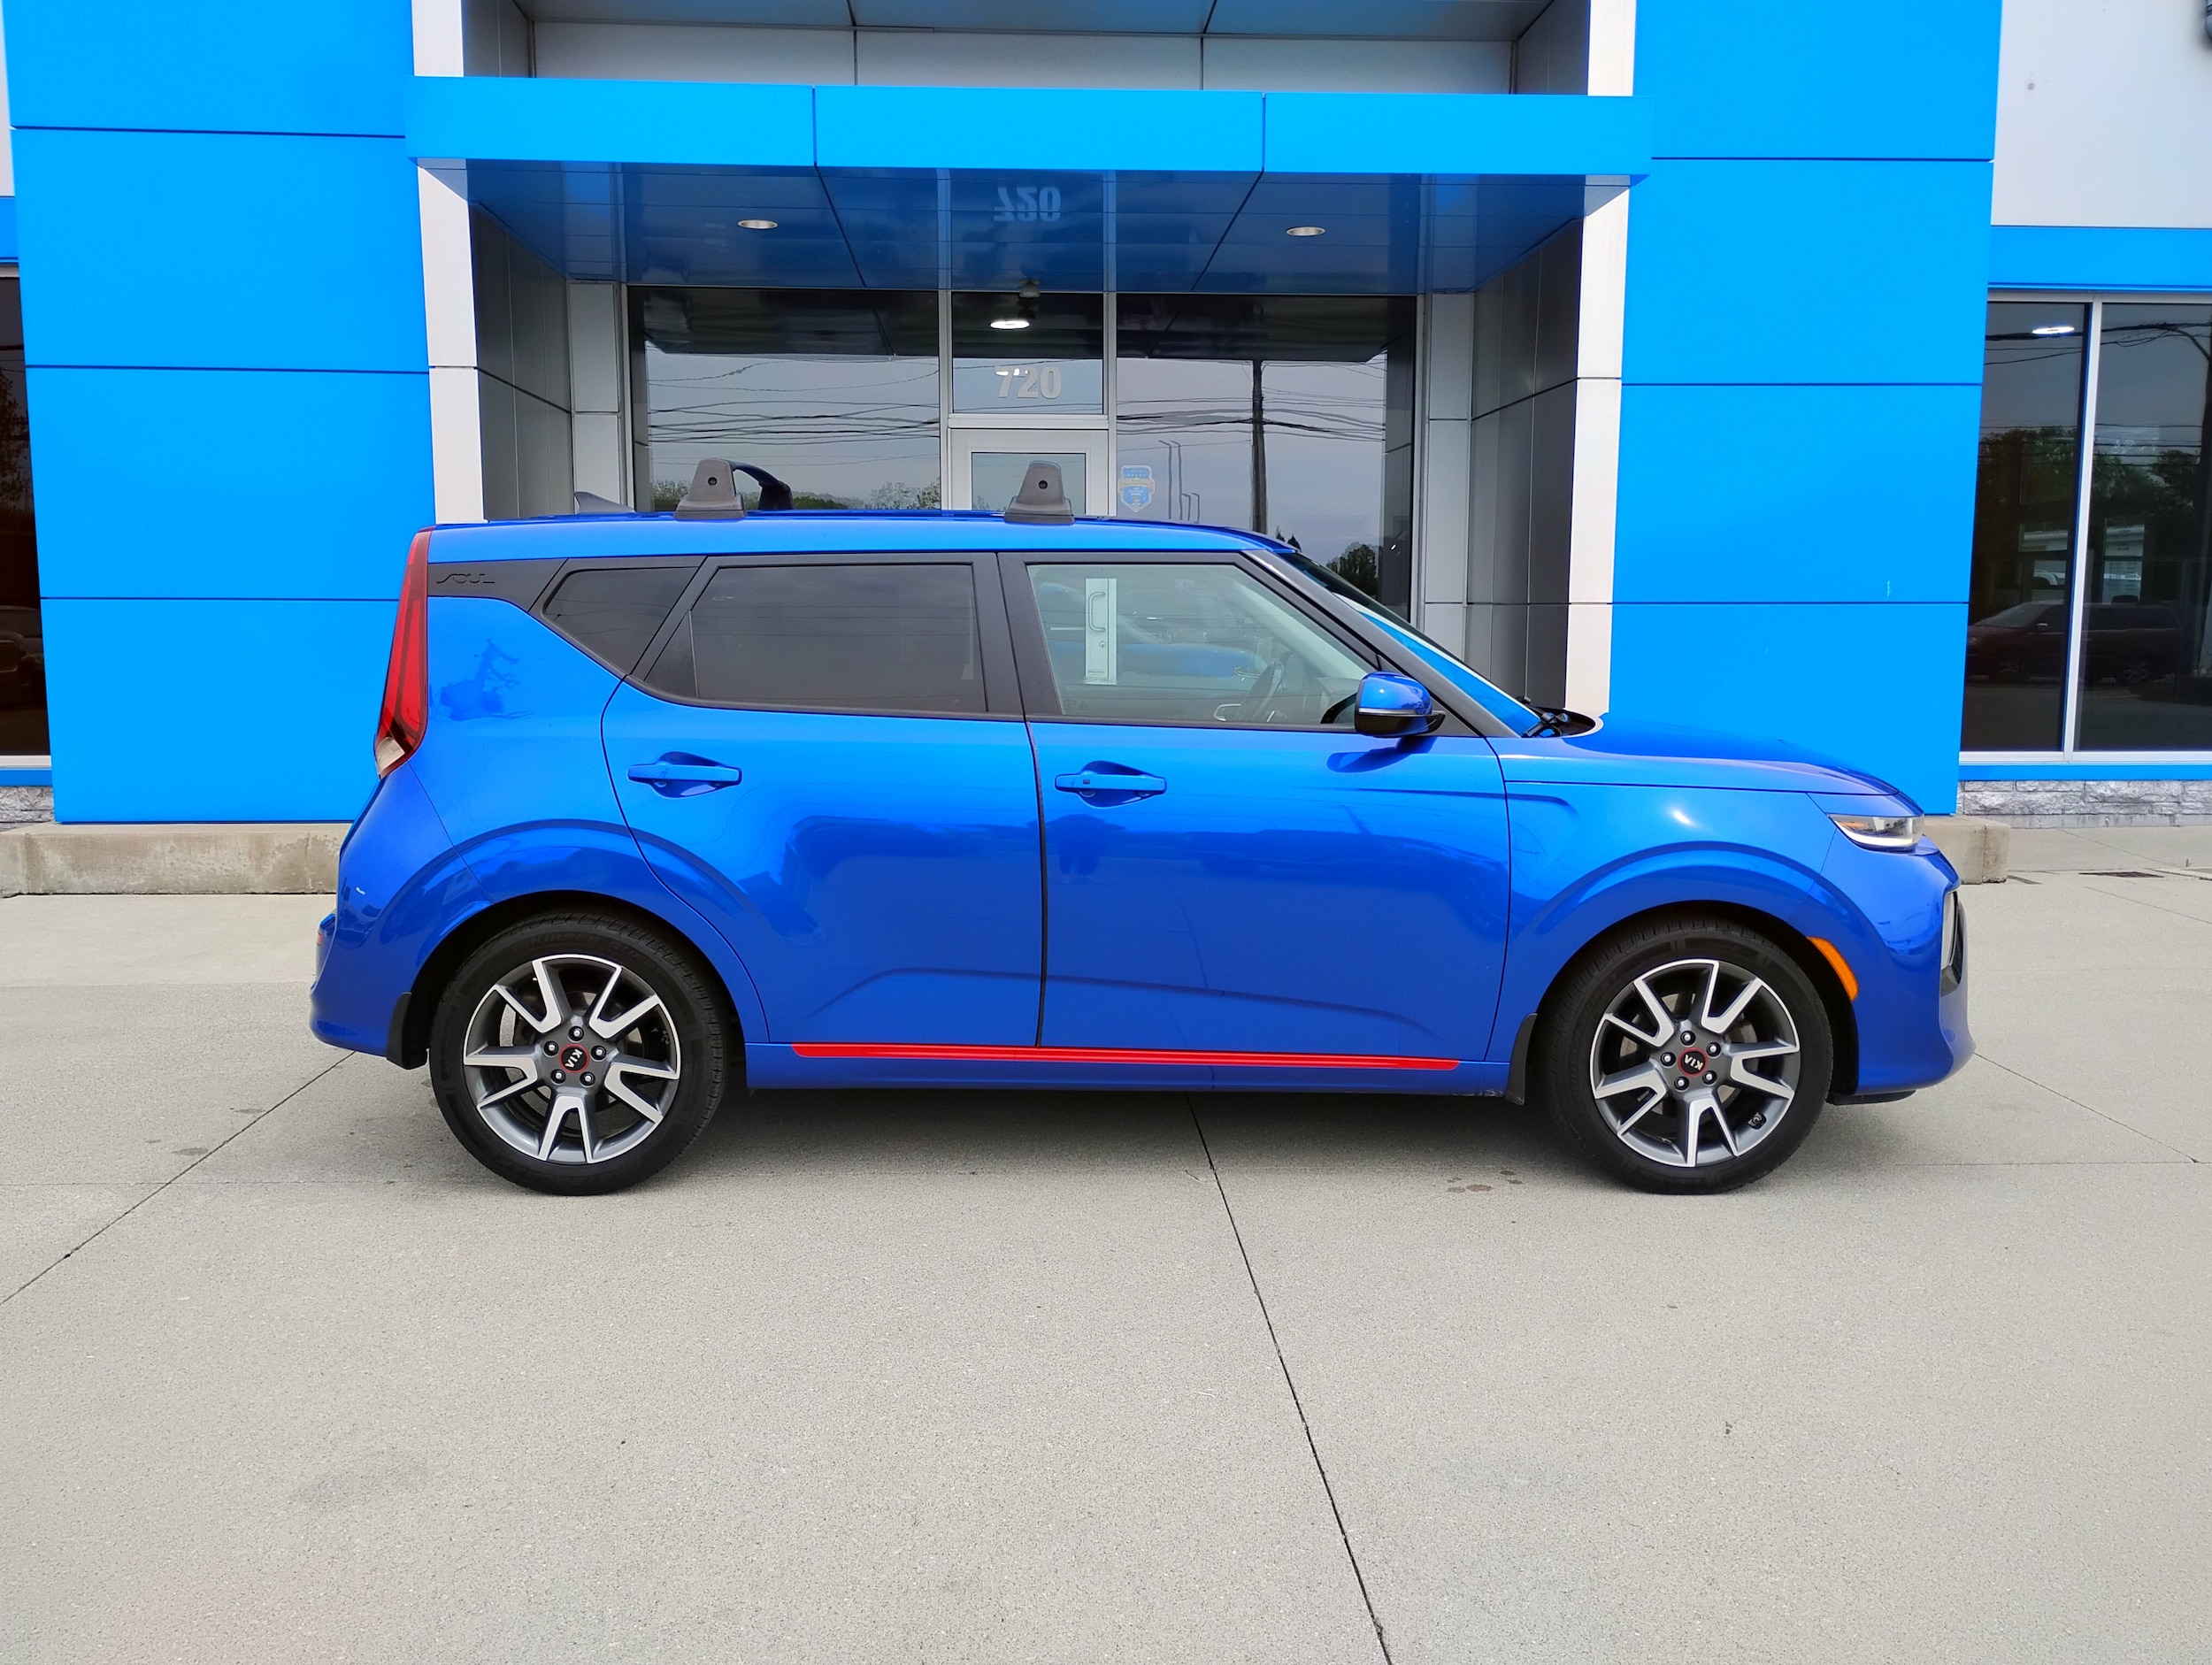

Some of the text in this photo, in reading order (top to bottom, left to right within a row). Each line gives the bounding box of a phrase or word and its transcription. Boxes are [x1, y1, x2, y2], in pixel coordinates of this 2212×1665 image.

[995, 365, 1062, 399] 720
[565, 1048, 583, 1068] KIA
[1684, 1054, 1703, 1071] KIA
